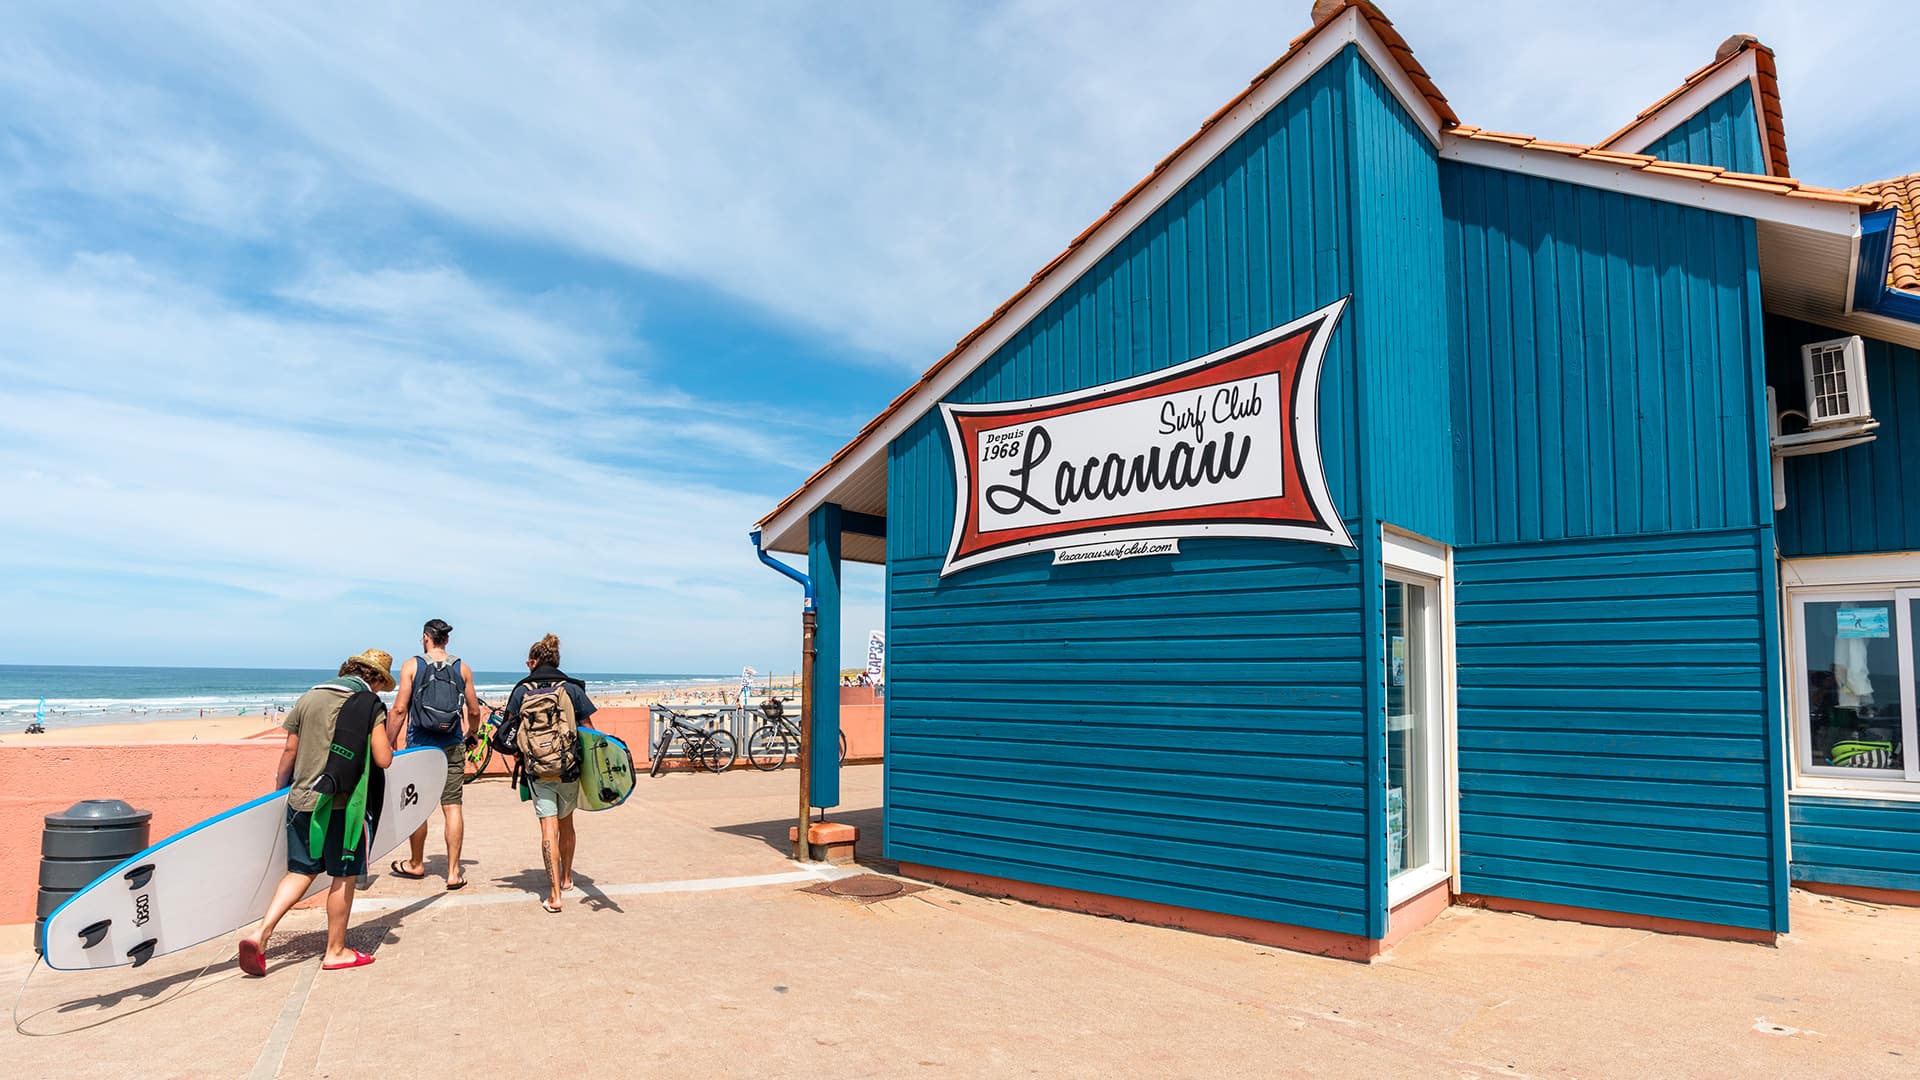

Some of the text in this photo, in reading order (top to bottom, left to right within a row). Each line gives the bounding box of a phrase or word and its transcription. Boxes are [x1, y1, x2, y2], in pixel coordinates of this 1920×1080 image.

[1159, 382, 1262, 443] Surf Club
[986, 429, 1024, 444] Depuis
[982, 441, 1020, 462] 1968
[985, 425, 1251, 515] Lacanau
[1059, 542, 1173, 561] lacanausurfclub.com
